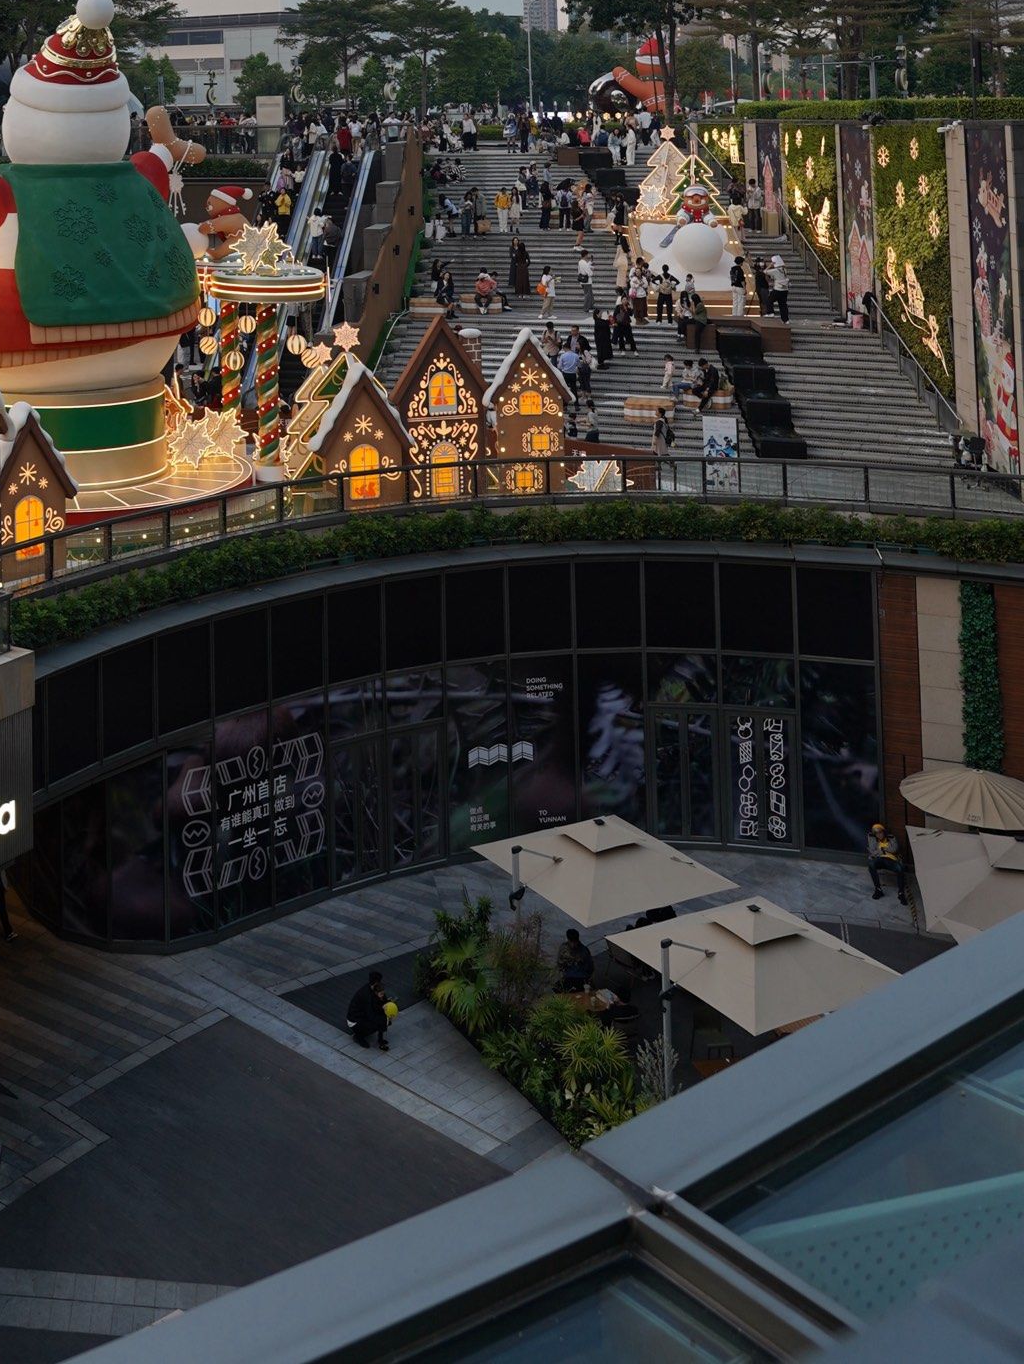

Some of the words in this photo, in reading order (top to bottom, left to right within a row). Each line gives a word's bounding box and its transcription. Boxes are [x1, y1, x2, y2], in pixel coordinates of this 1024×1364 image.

[526, 683, 563, 692] SOMETHING
[227, 774, 287, 811] 广州首店
[538, 815, 566, 824] YUNNAN
[227, 817, 288, 849] 一坐一忘
